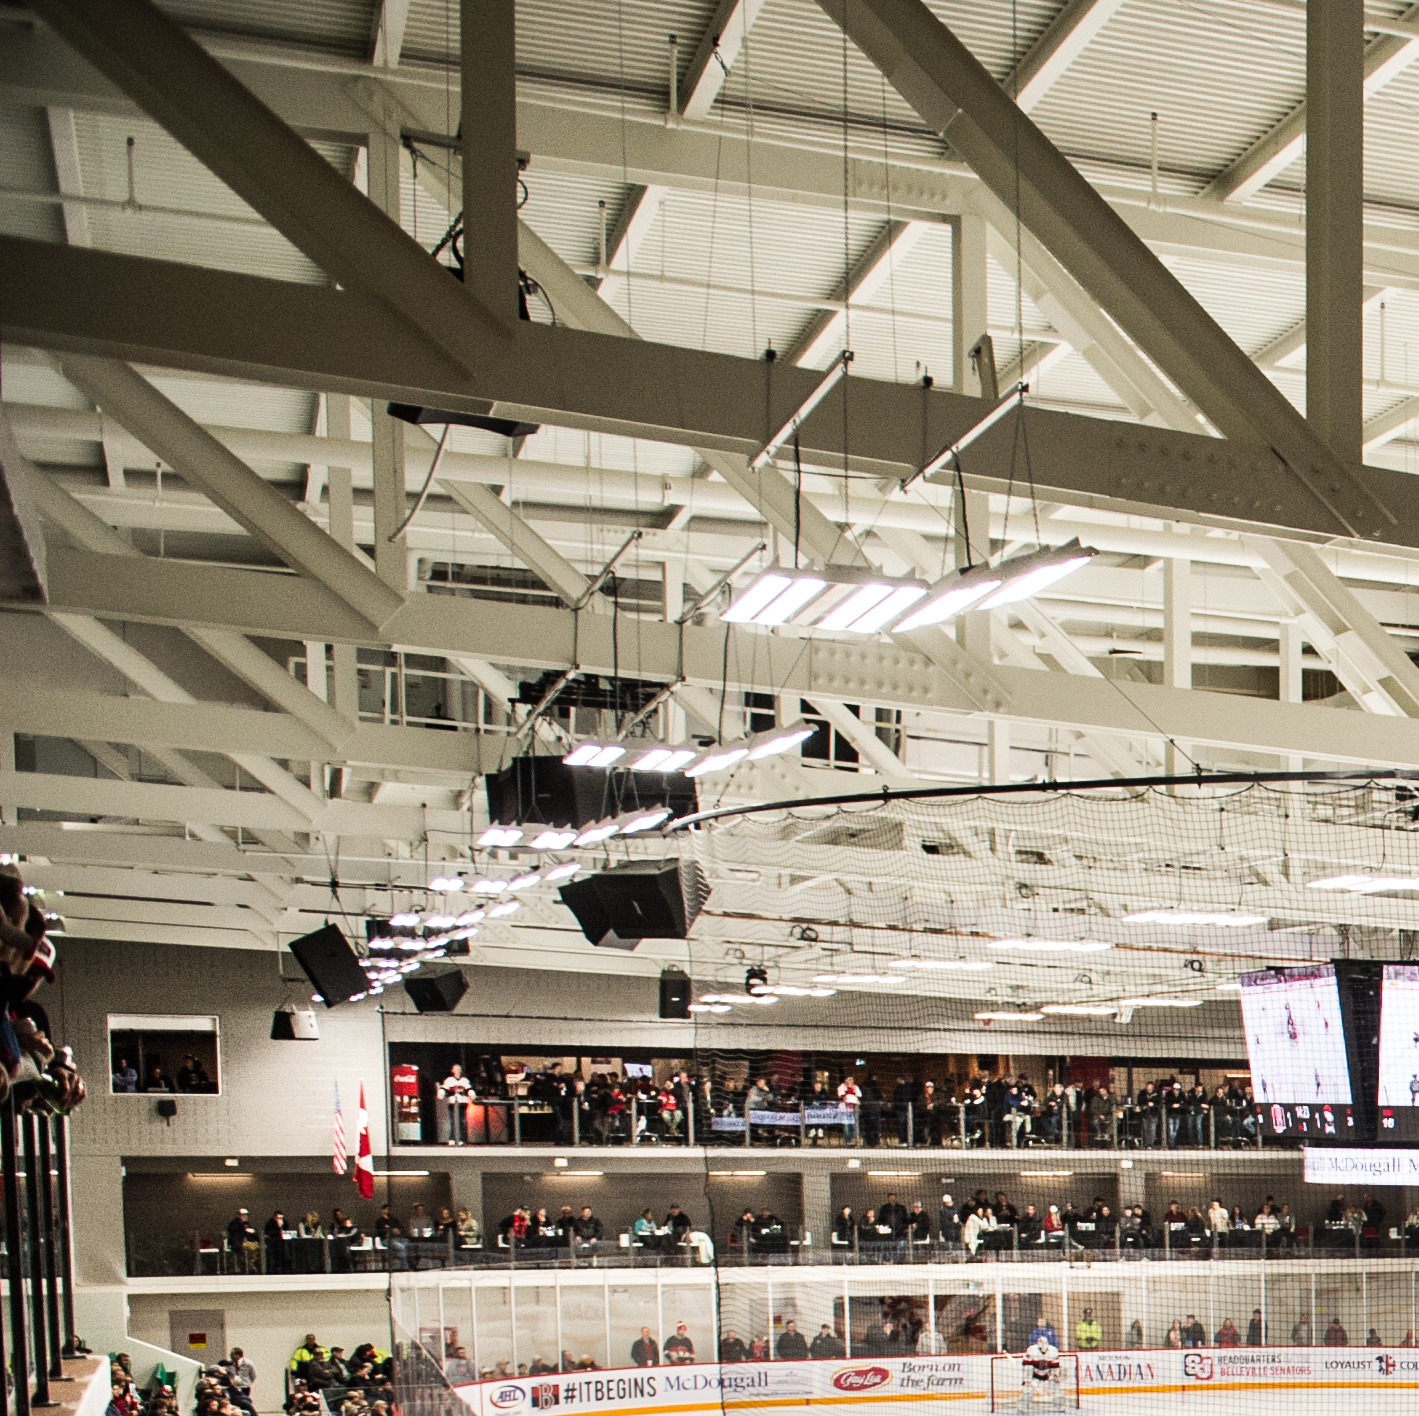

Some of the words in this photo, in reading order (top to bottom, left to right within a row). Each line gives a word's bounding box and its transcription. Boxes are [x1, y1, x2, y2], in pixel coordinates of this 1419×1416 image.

[1328, 1158, 1401, 1176] McDougall
[1218, 1355, 1282, 1365] HEADQUARTERS
[1325, 1360, 1373, 1370] LOYALIST
[901, 1362, 939, 1374] Born
[942, 1362, 962, 1373] on
[1220, 1366, 1268, 1377] BELLEVILLE
[1269, 1365, 1312, 1376] SENATORS
[664, 1371, 769, 1393] McDougall
[900, 1375, 923, 1388] the
[922, 1373, 964, 1391] farm
[494, 1389, 520, 1402] AHL
[563, 1376, 657, 1404] #ITBEGINS
